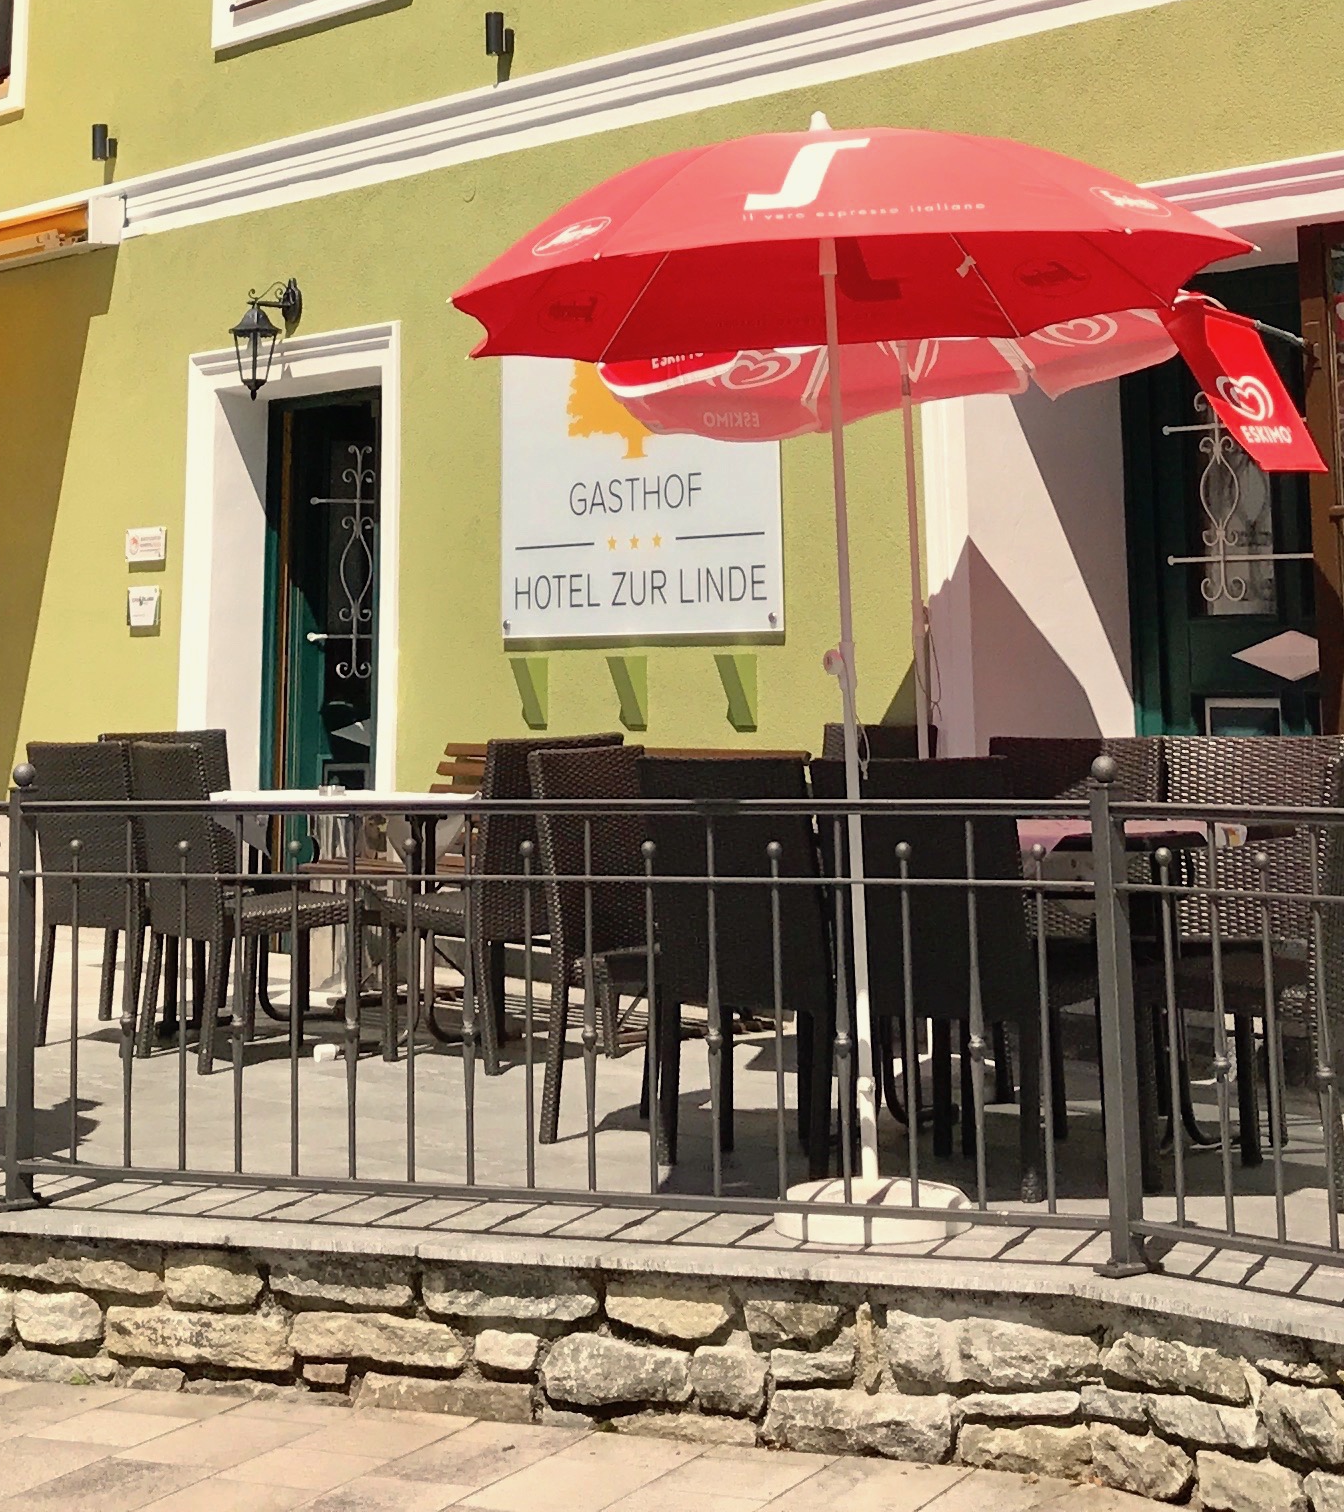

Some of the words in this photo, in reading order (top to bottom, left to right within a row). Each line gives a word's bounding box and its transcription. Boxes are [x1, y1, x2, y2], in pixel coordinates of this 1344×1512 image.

[764, 212, 805, 221] vero
[815, 207, 899, 219] espresso
[910, 202, 986, 214] italiano
[1239, 425, 1293, 445] ESKIMO
[569, 471, 703, 516] GASTHOF
[514, 573, 601, 610] HOTEL
[611, 569, 667, 606] ZUR
[680, 564, 768, 604] LINDE
